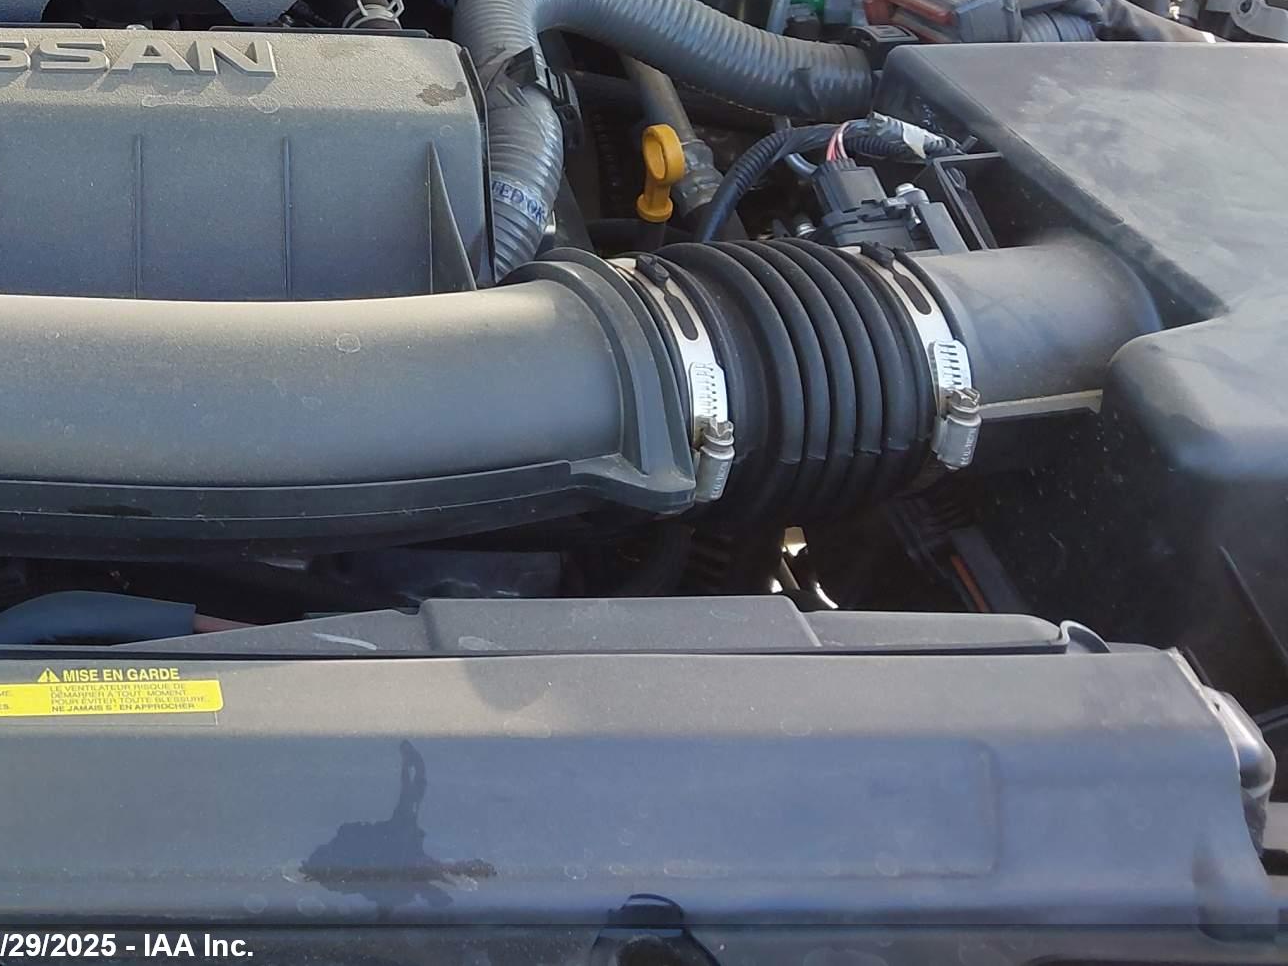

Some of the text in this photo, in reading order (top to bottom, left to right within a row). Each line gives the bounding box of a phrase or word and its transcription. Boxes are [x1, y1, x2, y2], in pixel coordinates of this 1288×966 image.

[62, 667, 181, 682] MISE EN GARDE
[67, 704, 104, 712] JAMAIS
